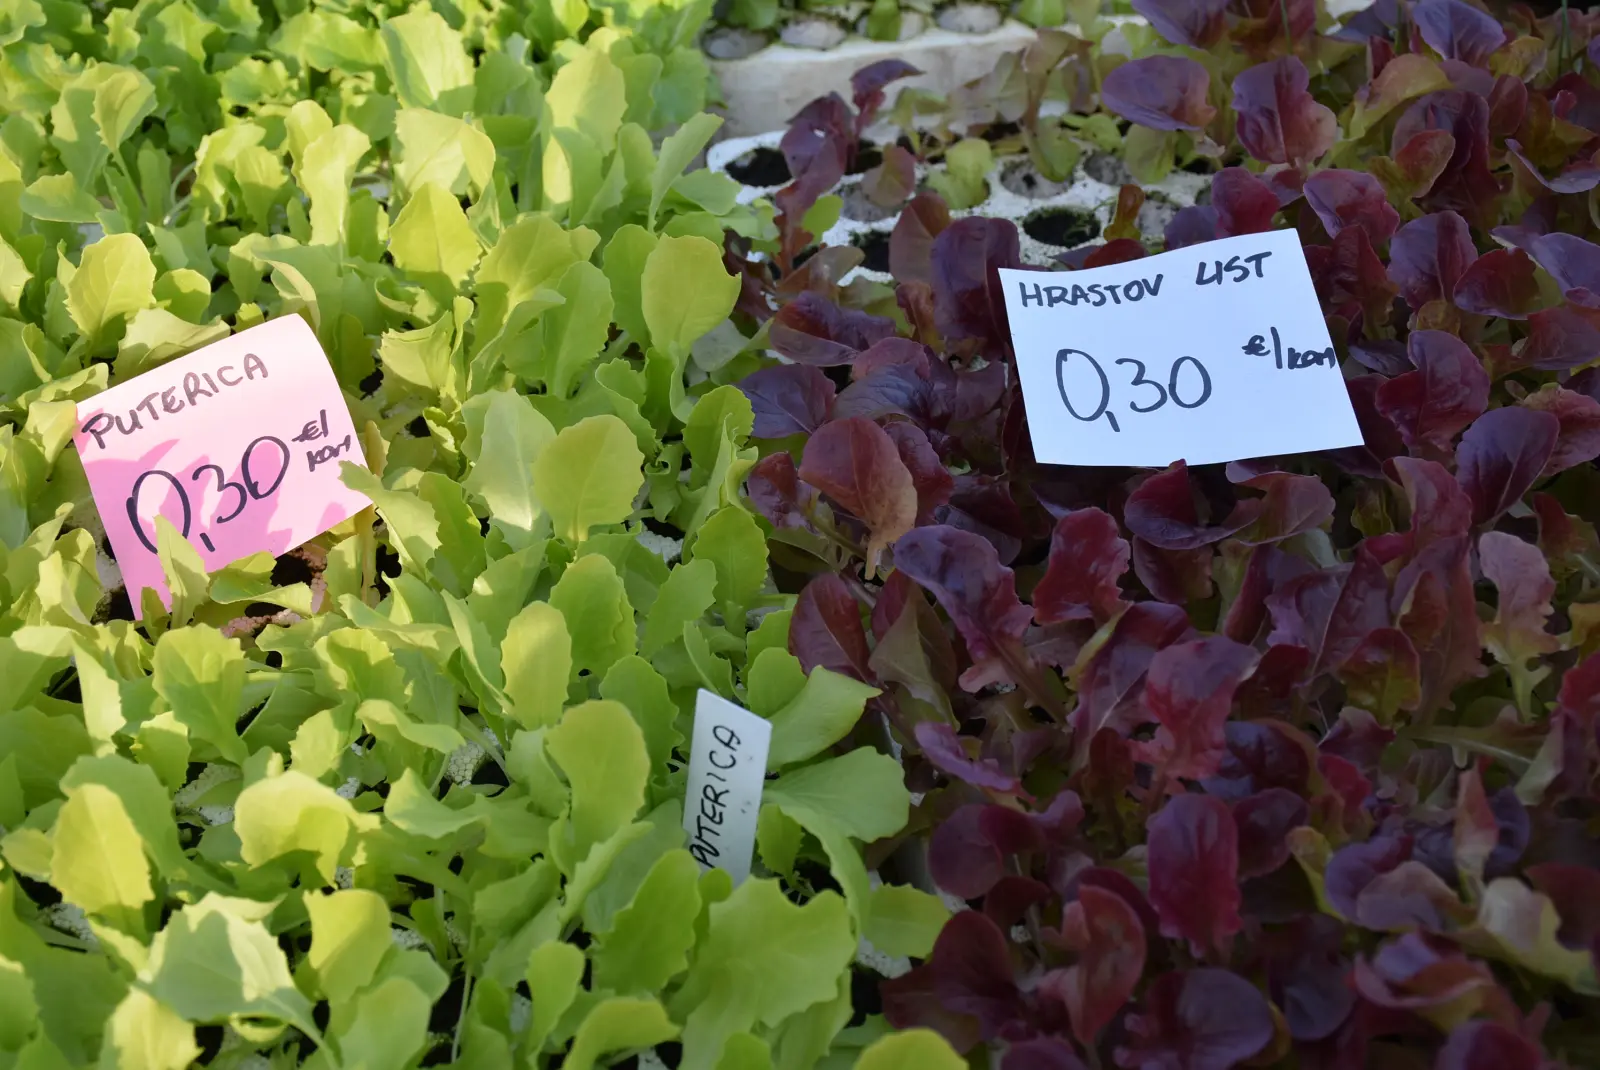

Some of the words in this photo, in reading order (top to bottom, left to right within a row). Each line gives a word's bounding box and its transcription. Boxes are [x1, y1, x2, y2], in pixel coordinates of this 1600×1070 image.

[1018, 273, 1164, 308] HRASTOV
[1195, 251, 1273, 286] LIST
[81, 353, 269, 449] PUTERICA
[1055, 347, 1213, 433] 0,30
[125, 435, 291, 554] 0,30
[688, 724, 742, 868] PUTERICA
